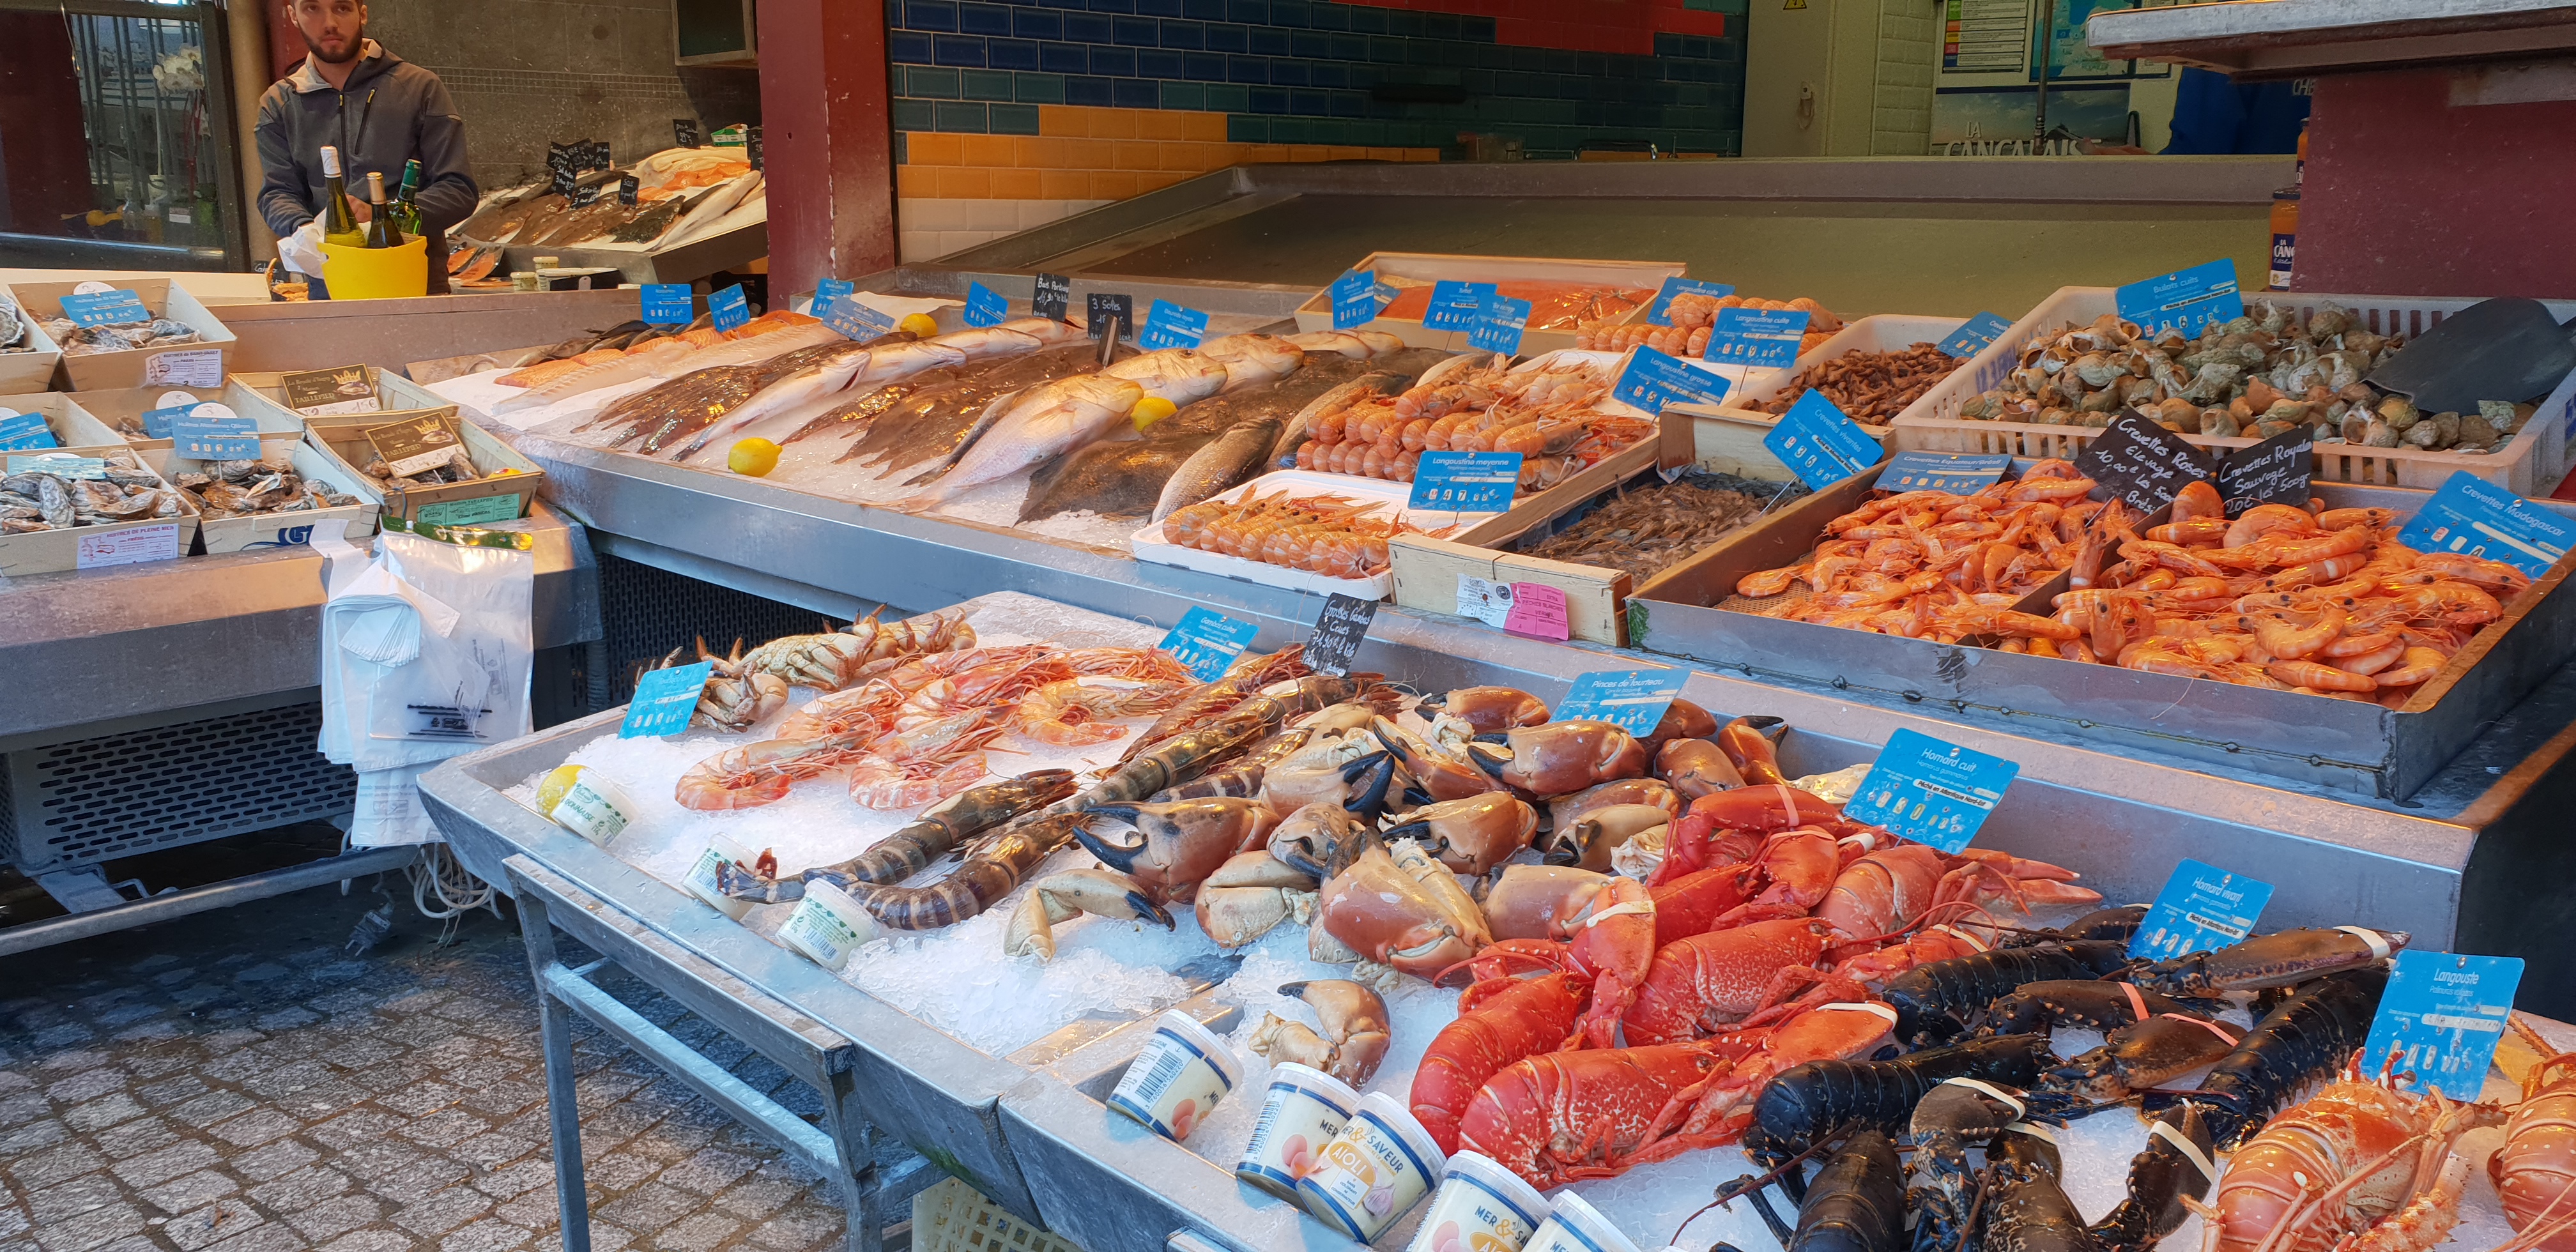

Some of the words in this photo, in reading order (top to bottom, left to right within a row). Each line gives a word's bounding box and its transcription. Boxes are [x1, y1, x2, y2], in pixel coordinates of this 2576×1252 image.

[1967, 122, 1981, 138] LA
[2153, 281, 2178, 294] Bulots
[2180, 277, 2200, 289] cuits
[1092, 298, 1099, 310] 3
[1735, 315, 1772, 324] Langoustine
[1650, 357, 1690, 378] Langoustine
[1689, 374, 1712, 387] grosse
[294, 392, 335, 404] TAILLEPIED
[1814, 409, 1841, 434] Crevettes
[1839, 431, 1862, 453] vivantes
[385, 443, 421, 457] TAILLEPIED
[2117, 418, 2169, 457] Crevettes
[2172, 452, 2207, 478] Roses
[1432, 457, 1475, 466] Langoustine
[1903, 456, 1940, 464] Crevettes
[2220, 454, 2272, 484] Crevettes
[2234, 467, 2288, 495] Sauvage
[2259, 487, 2274, 500] les
[2280, 473, 2311, 492] 500gr
[2462, 485, 2506, 510] Crevettes
[2503, 505, 2567, 537] Madagascar
[1324, 600, 1349, 622] Grosses
[1200, 616, 1222, 629] Gambas
[1222, 624, 1238, 634] cuites
[1591, 680, 1618, 688] Pinces
[1630, 678, 1664, 687] tourteau
[1921, 748, 1958, 767] Homard
[1958, 761, 1977, 774] cuit
[1917, 781, 1933, 790] Pêché
[1940, 788, 1965, 801] Atlantique
[1964, 795, 1986, 806] Nord-Est
[2192, 876, 2223, 896] Homard
[2221, 889, 2244, 903] vivant
[2434, 968, 2480, 986] Langouste
[1319, 1118, 1339, 1138] MER
[1349, 1127, 1367, 1143] &
[1367, 1135, 1404, 1174] SAVEUR
[1331, 1145, 1367, 1177] AÏOLI
[1340, 1181, 1358, 1196] COLORANT
[1346, 1180, 1356, 1189] SANS
[1331, 1187, 1356, 1207] CONSERVATEUR
[1475, 1205, 1498, 1228] MER
[1495, 1218, 1515, 1239] &
